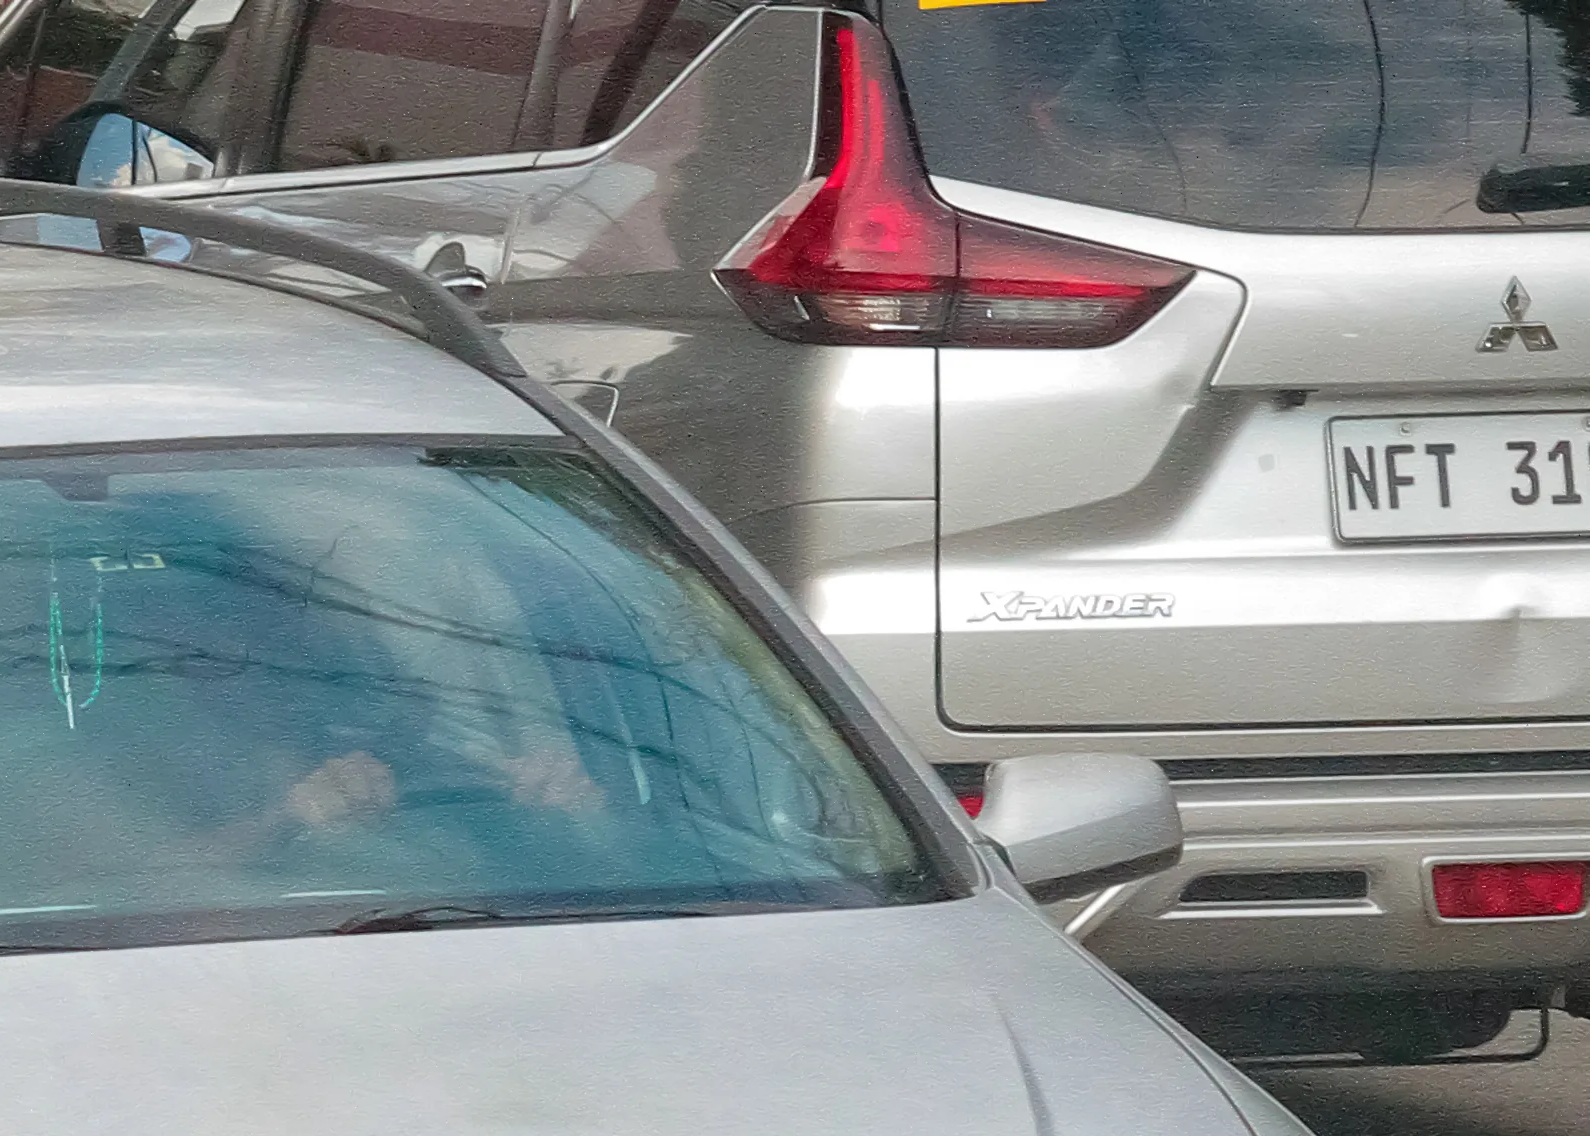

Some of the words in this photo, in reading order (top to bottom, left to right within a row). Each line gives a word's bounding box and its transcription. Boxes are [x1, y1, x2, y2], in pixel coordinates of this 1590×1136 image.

[1343, 442, 1456, 510] NFT
[1505, 440, 1590, 506] 31
[966, 591, 1176, 623] XPANDER
